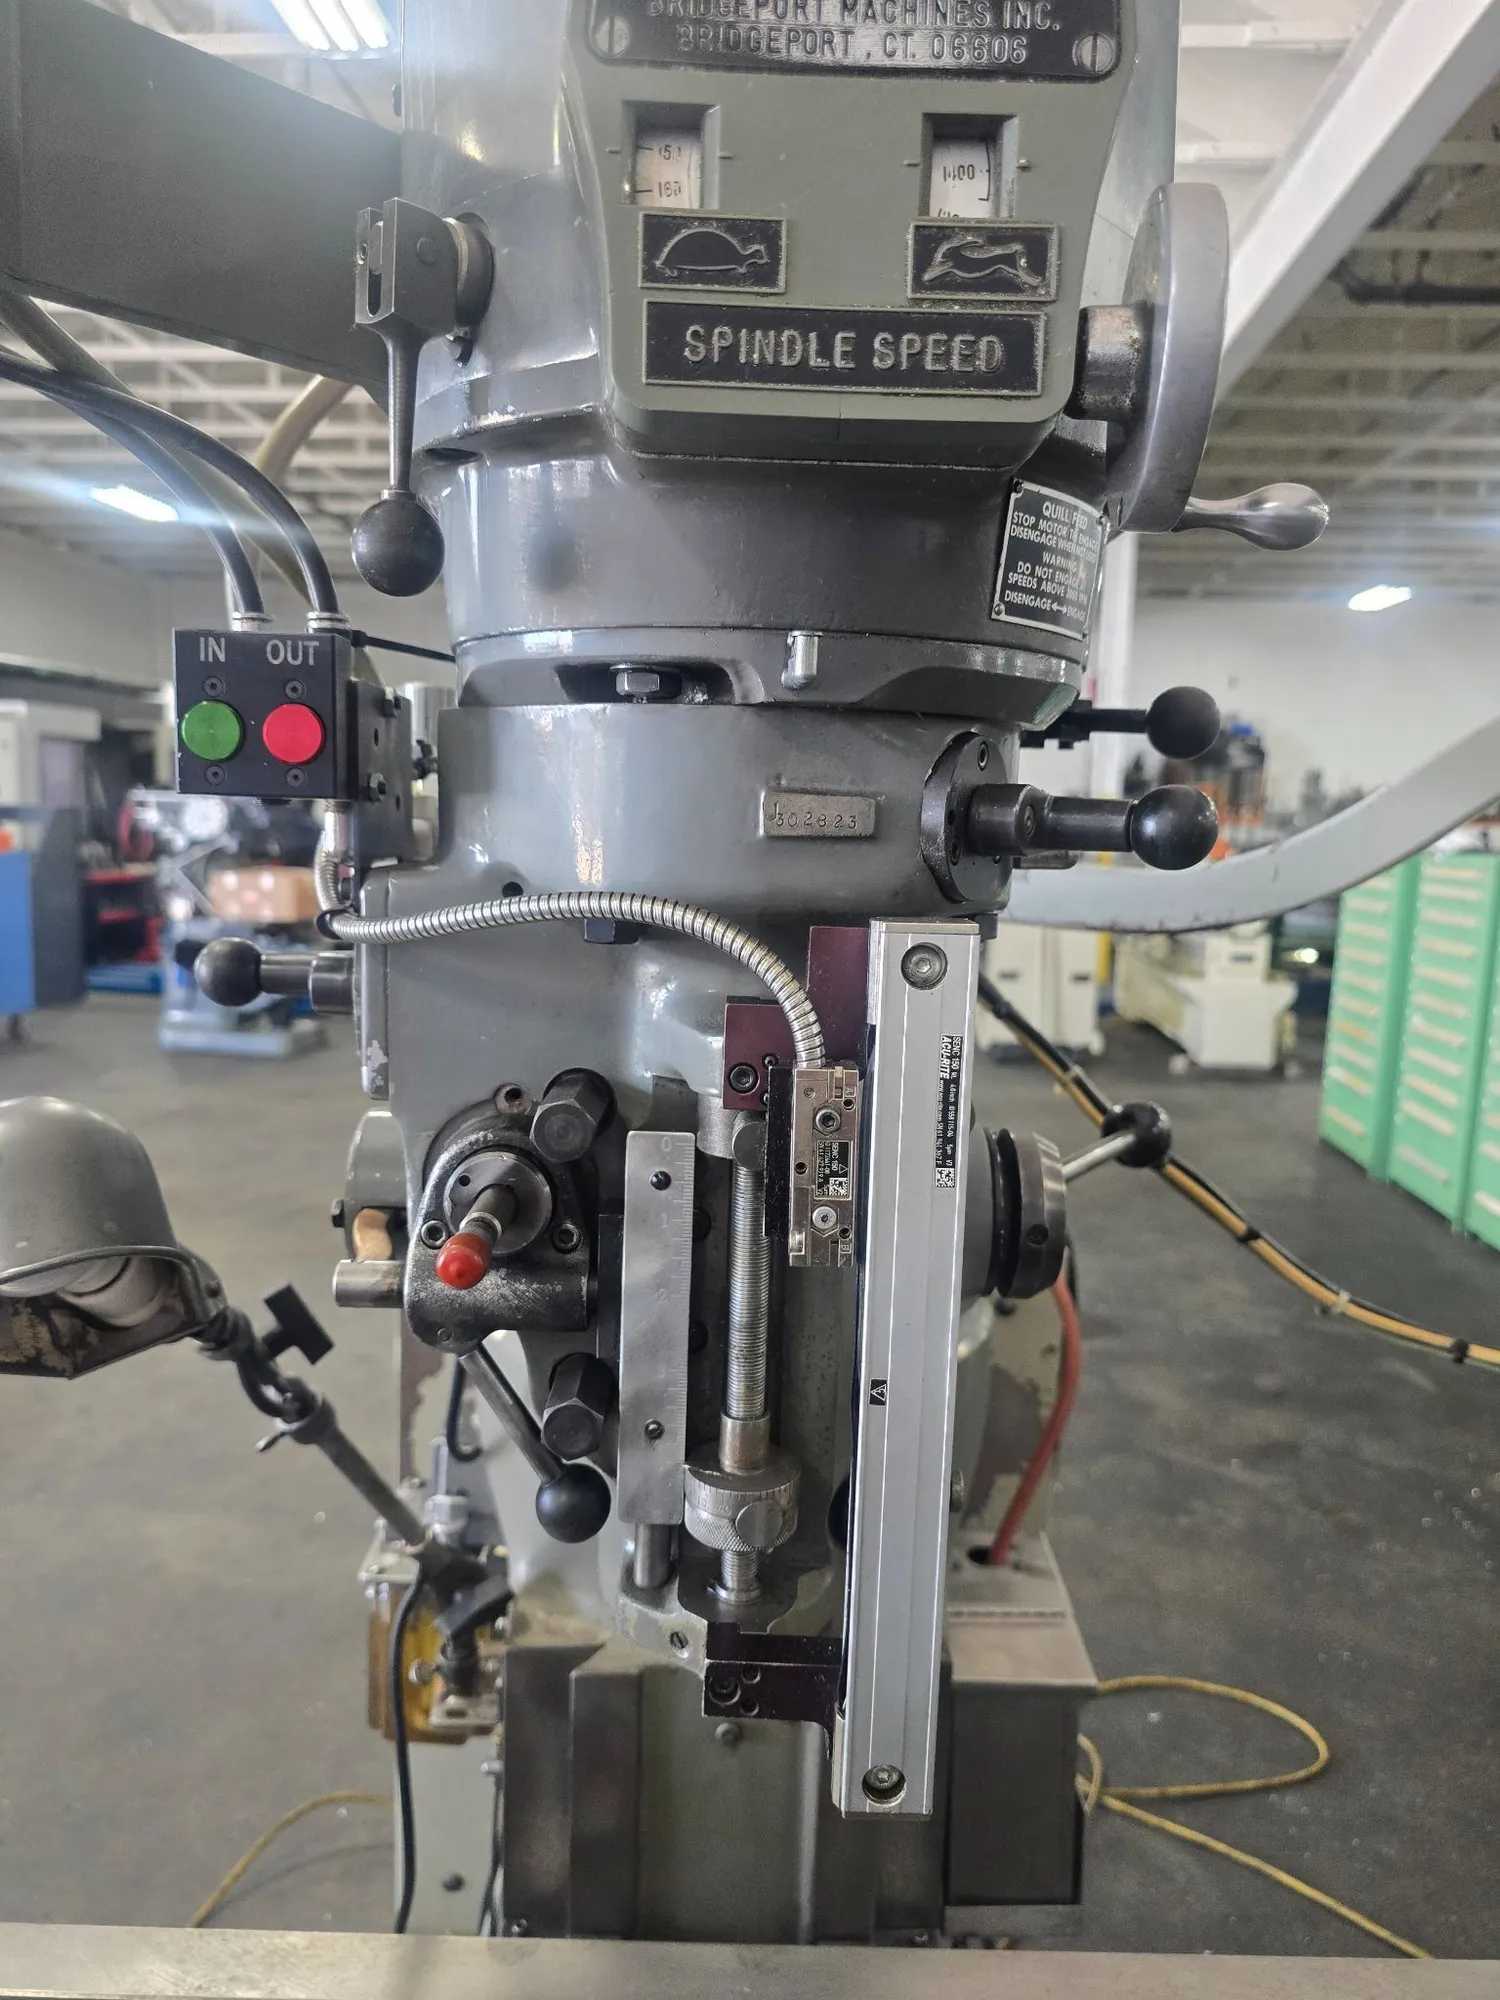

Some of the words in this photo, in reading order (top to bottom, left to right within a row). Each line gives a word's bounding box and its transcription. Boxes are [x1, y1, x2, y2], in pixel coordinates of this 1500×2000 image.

[648, 0, 826, 22] BRIDGEPORT
[843, 0, 991, 28] MACHINES
[1001, 1, 1061, 31] INC.
[930, 33, 1028, 64] 06606
[683, 324, 857, 369] SPINDLE
[871, 331, 1003, 373] SPEED
[1042, 501, 1070, 523] QUILL
[1010, 524, 1057, 548] DISENGAGE
[1012, 511, 1036, 528] STOP
[1038, 518, 1068, 539] MOTOR
[1017, 561, 1032, 575] DO
[1034, 565, 1053, 580] NOT
[1042, 551, 1077, 574] WARNING
[1007, 572, 1037, 589] SPEEDS
[1040, 579, 1065, 597] ABOVE
[1004, 590, 1052, 612] DISENGAGE
[199, 637, 226, 663] IN
[266, 639, 320, 666] OUT
[952, 1036, 961, 1056] SENC
[951, 1058, 960, 1070] 150
[831, 1160, 839, 1171] 150
